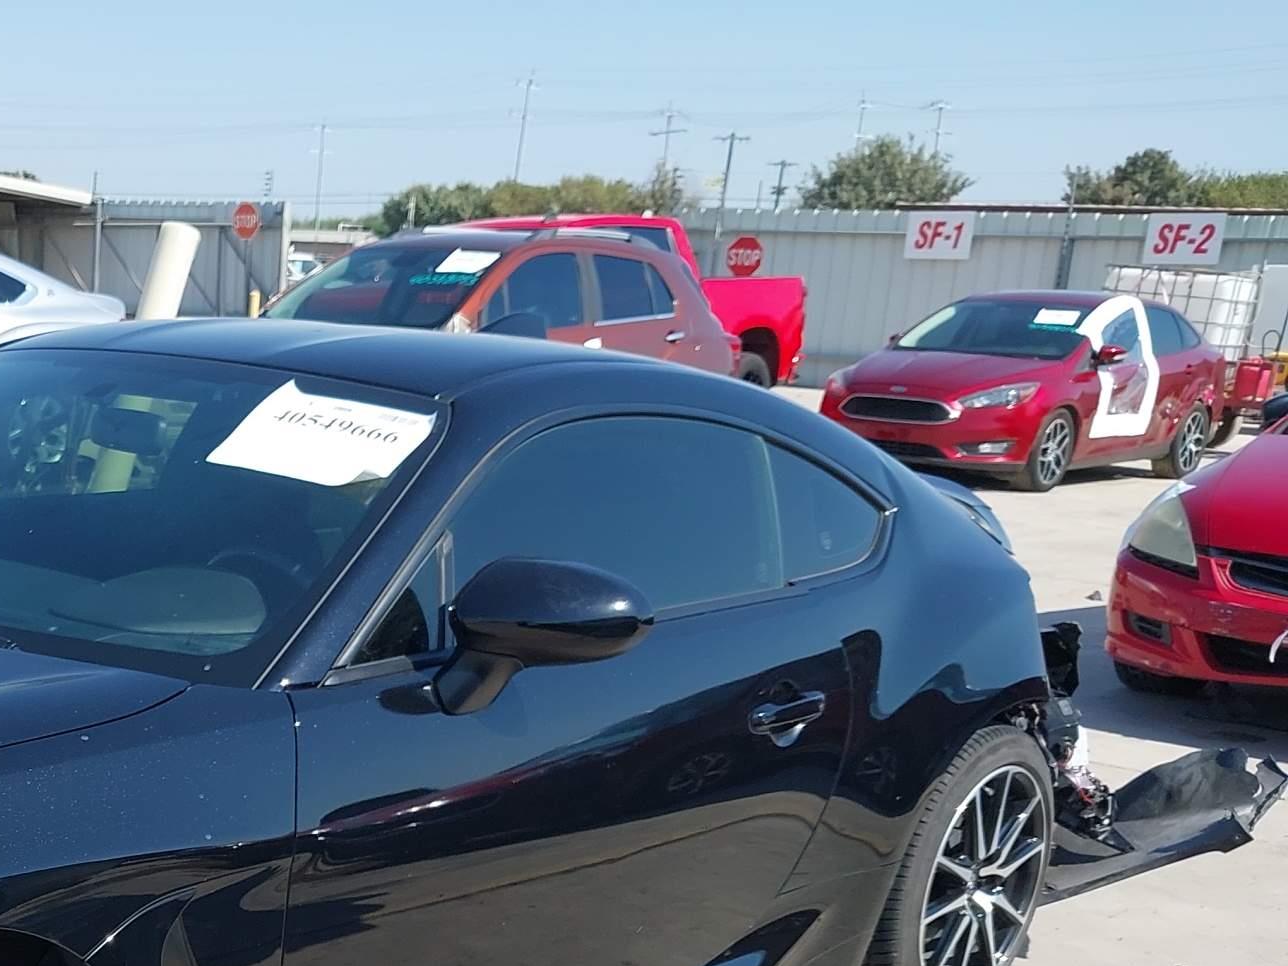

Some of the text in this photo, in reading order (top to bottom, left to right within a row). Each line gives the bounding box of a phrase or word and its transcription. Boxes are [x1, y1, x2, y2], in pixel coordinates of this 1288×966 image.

[235, 215, 257, 228] STOP
[914, 220, 964, 249] SF-1
[1152, 223, 1216, 254] SF-2
[728, 248, 761, 266] STOP
[274, 409, 398, 444] 40549666
